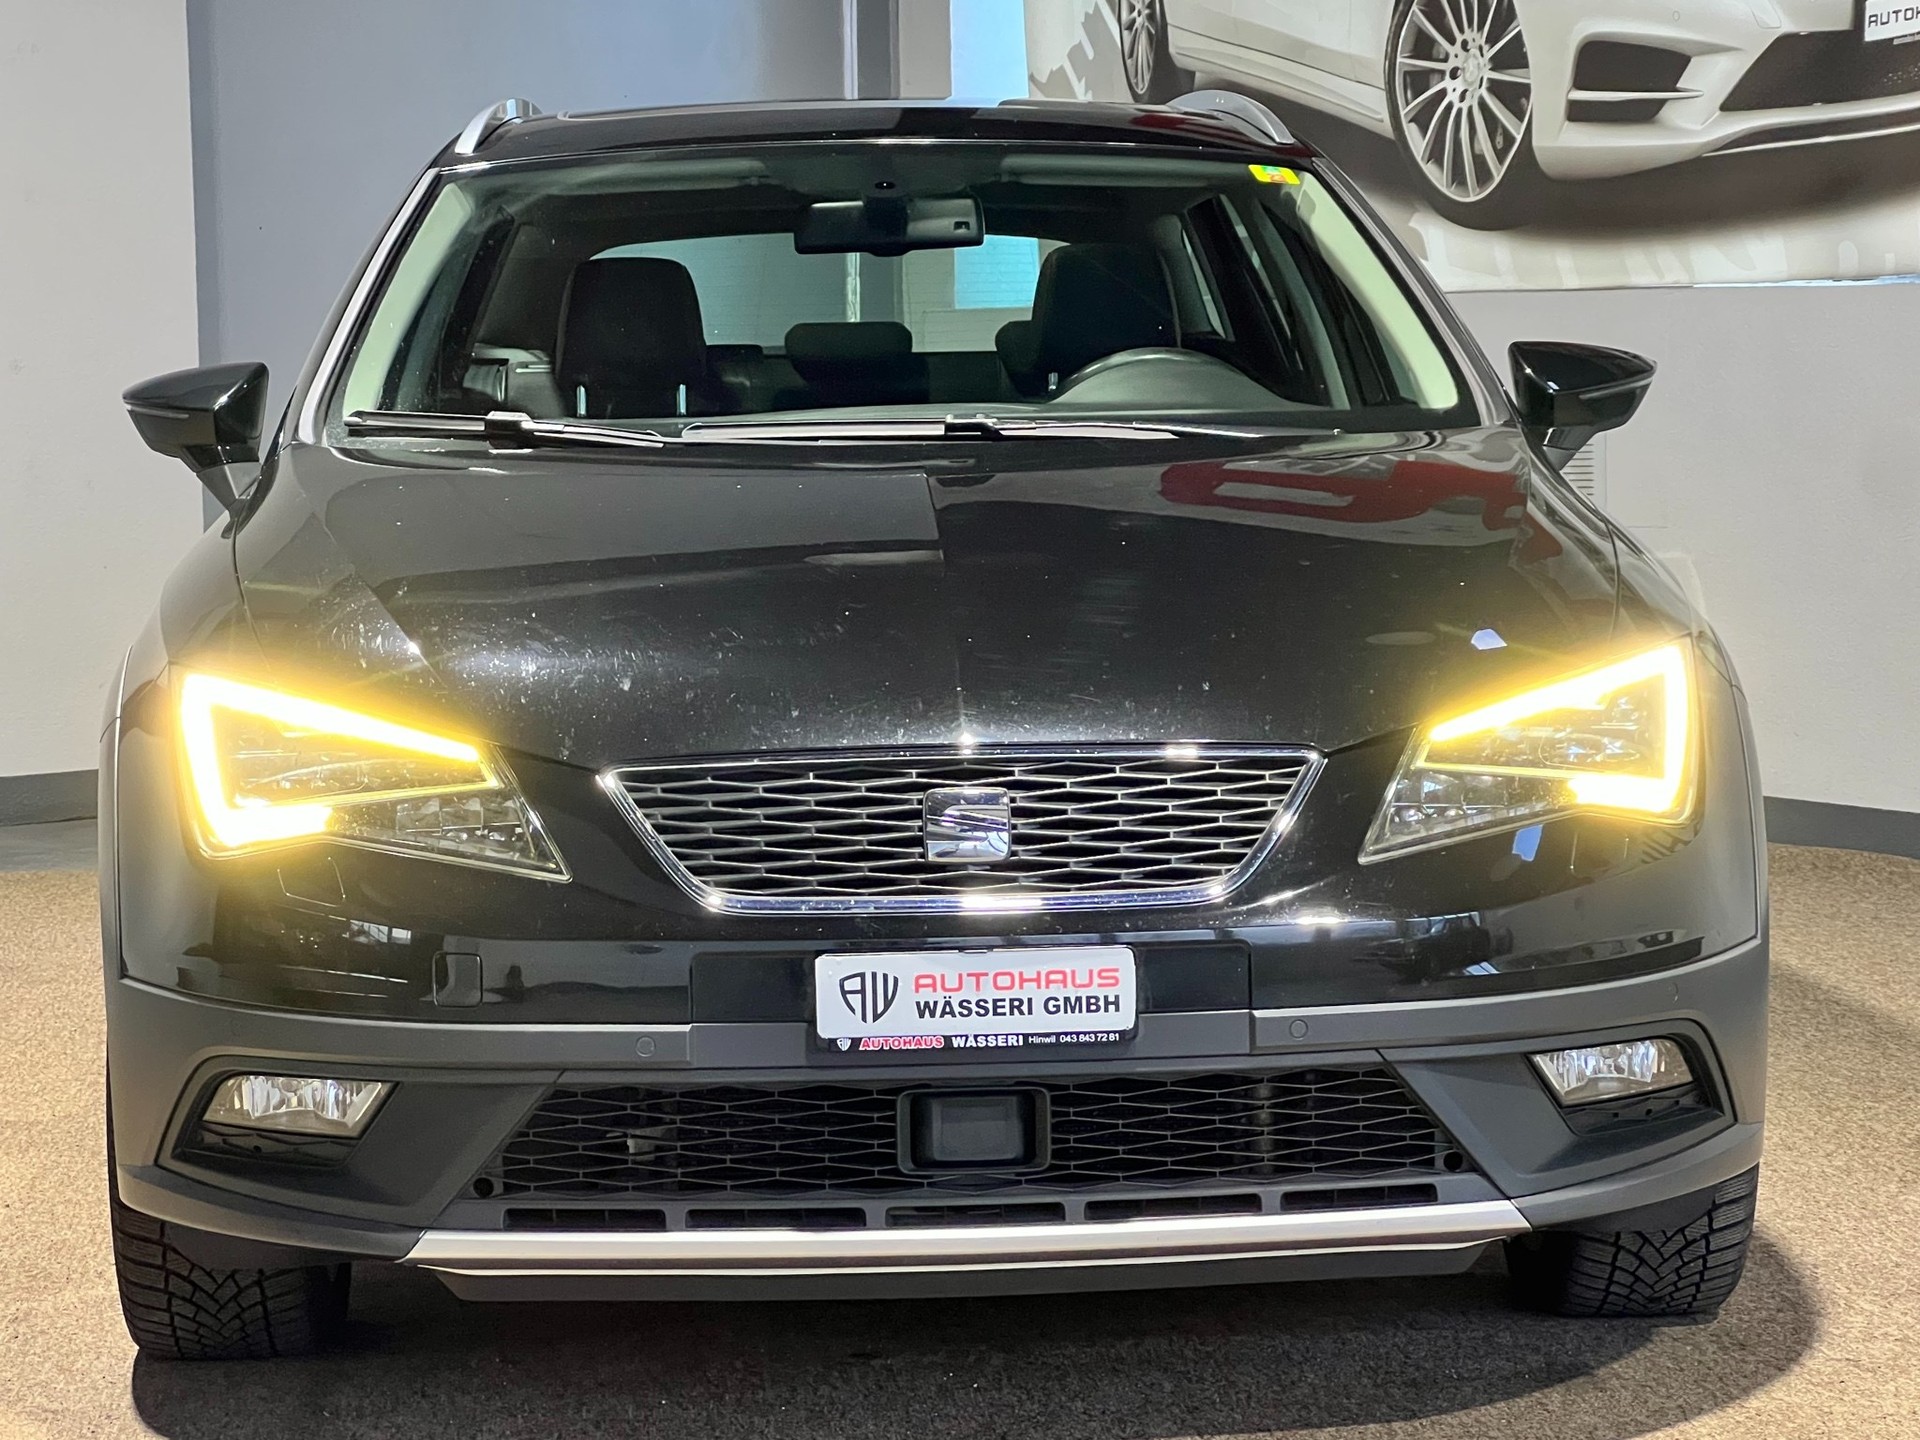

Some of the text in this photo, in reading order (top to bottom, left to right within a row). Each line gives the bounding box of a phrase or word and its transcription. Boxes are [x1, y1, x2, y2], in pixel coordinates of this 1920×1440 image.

[913, 966, 1121, 994] AUTOHAUS
[915, 994, 1121, 1020] WÄSSERI GMBH
[859, 1035, 945, 1051] AUTOHAUS
[951, 1034, 1024, 1048] WÄSSERI
[1028, 1034, 1056, 1044] Hinwil
[1059, 1033, 1077, 1043] 043
[1078, 1032, 1096, 1042] 843
[1096, 1032, 1108, 1042] 72
[1108, 1032, 1120, 1041] 81
